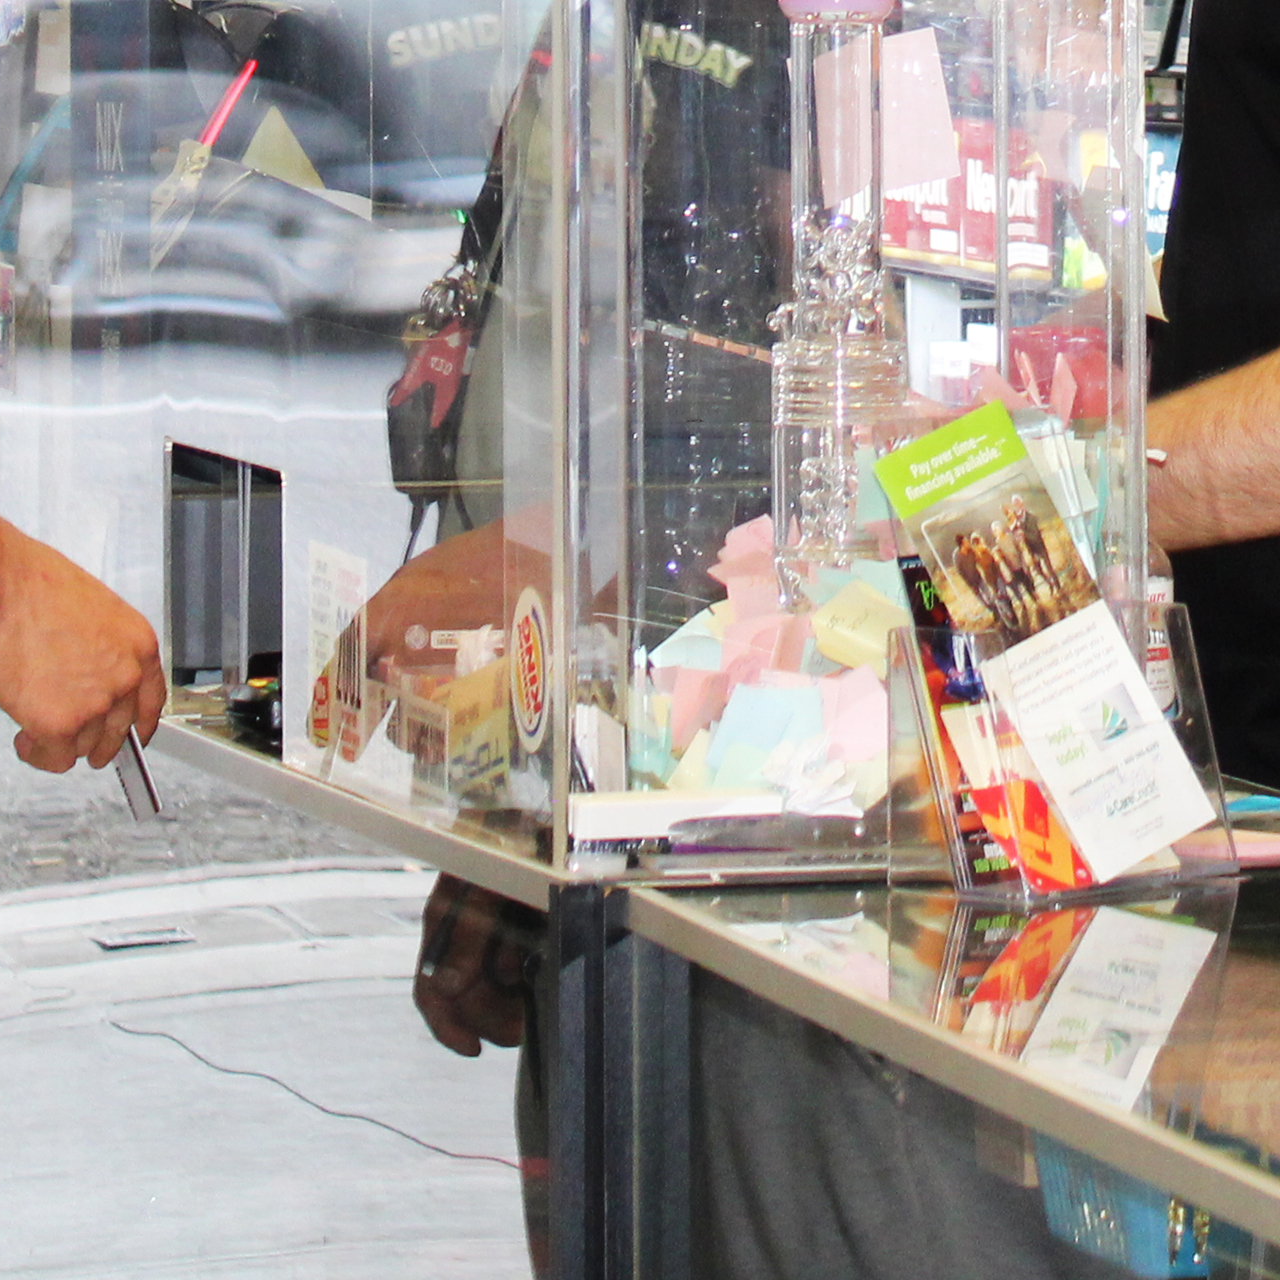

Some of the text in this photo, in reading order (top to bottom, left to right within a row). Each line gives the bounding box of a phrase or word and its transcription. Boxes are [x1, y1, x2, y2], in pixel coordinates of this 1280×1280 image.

[386, 13, 506, 68] SUND
[641, 24, 754, 88] NDAY
[965, 157, 1040, 219] Neort
[905, 467, 956, 502] financing
[909, 458, 931, 479] Pay
[930, 446, 954, 468] over
[521, 615, 543, 715] KING
[1056, 742, 1088, 767] today!
